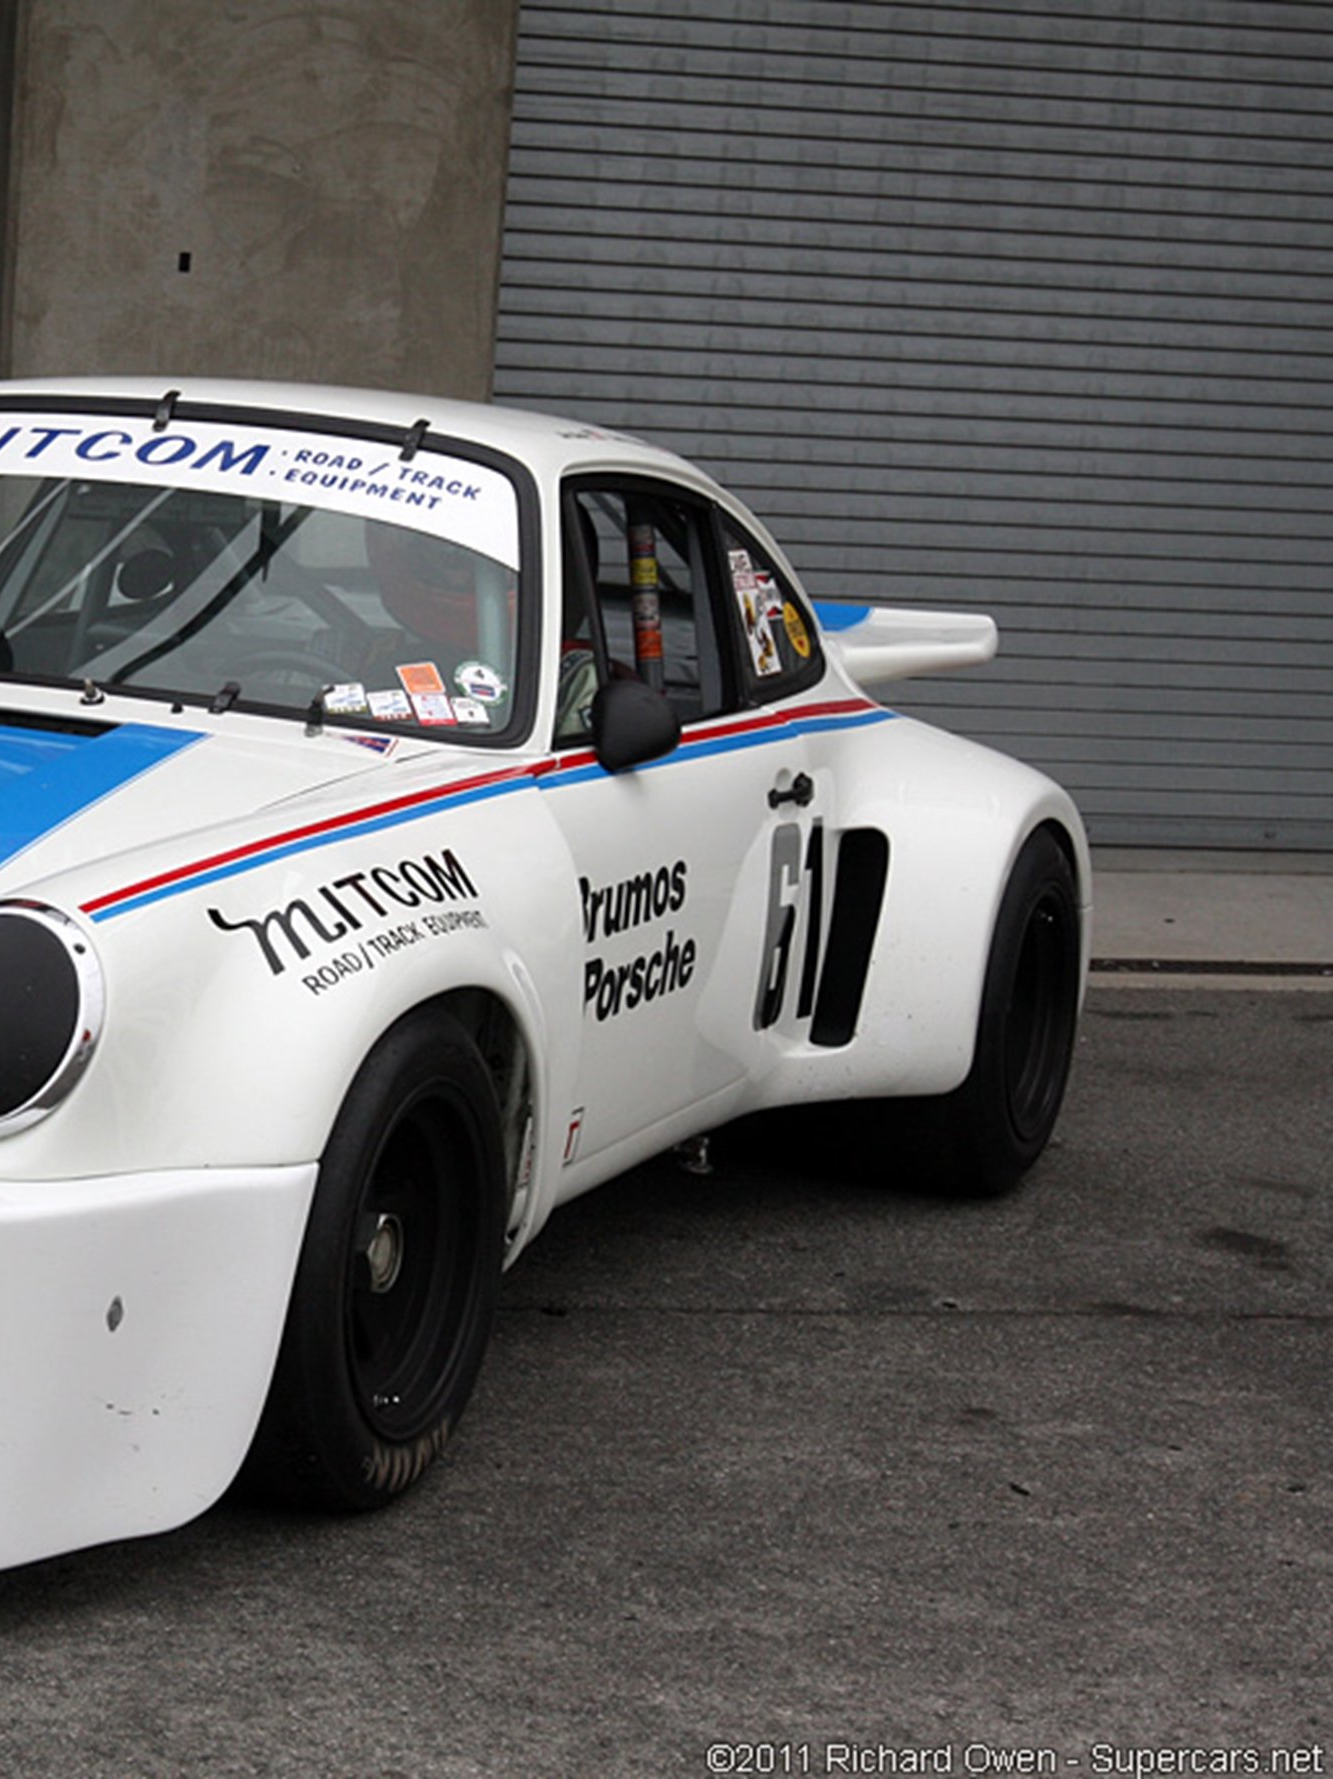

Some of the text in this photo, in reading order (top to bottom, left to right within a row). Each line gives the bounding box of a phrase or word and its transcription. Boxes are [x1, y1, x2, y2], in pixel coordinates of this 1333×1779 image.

[284, 469, 444, 511] EQUIPMENT
[294, 449, 364, 472] ROAD
[397, 465, 482, 502] TRACK
[207, 848, 479, 976] MITCOM
[422, 910, 488, 938] EQUIPMENT
[752, 816, 824, 1032] 61
[583, 929, 696, 1022] Porsche
